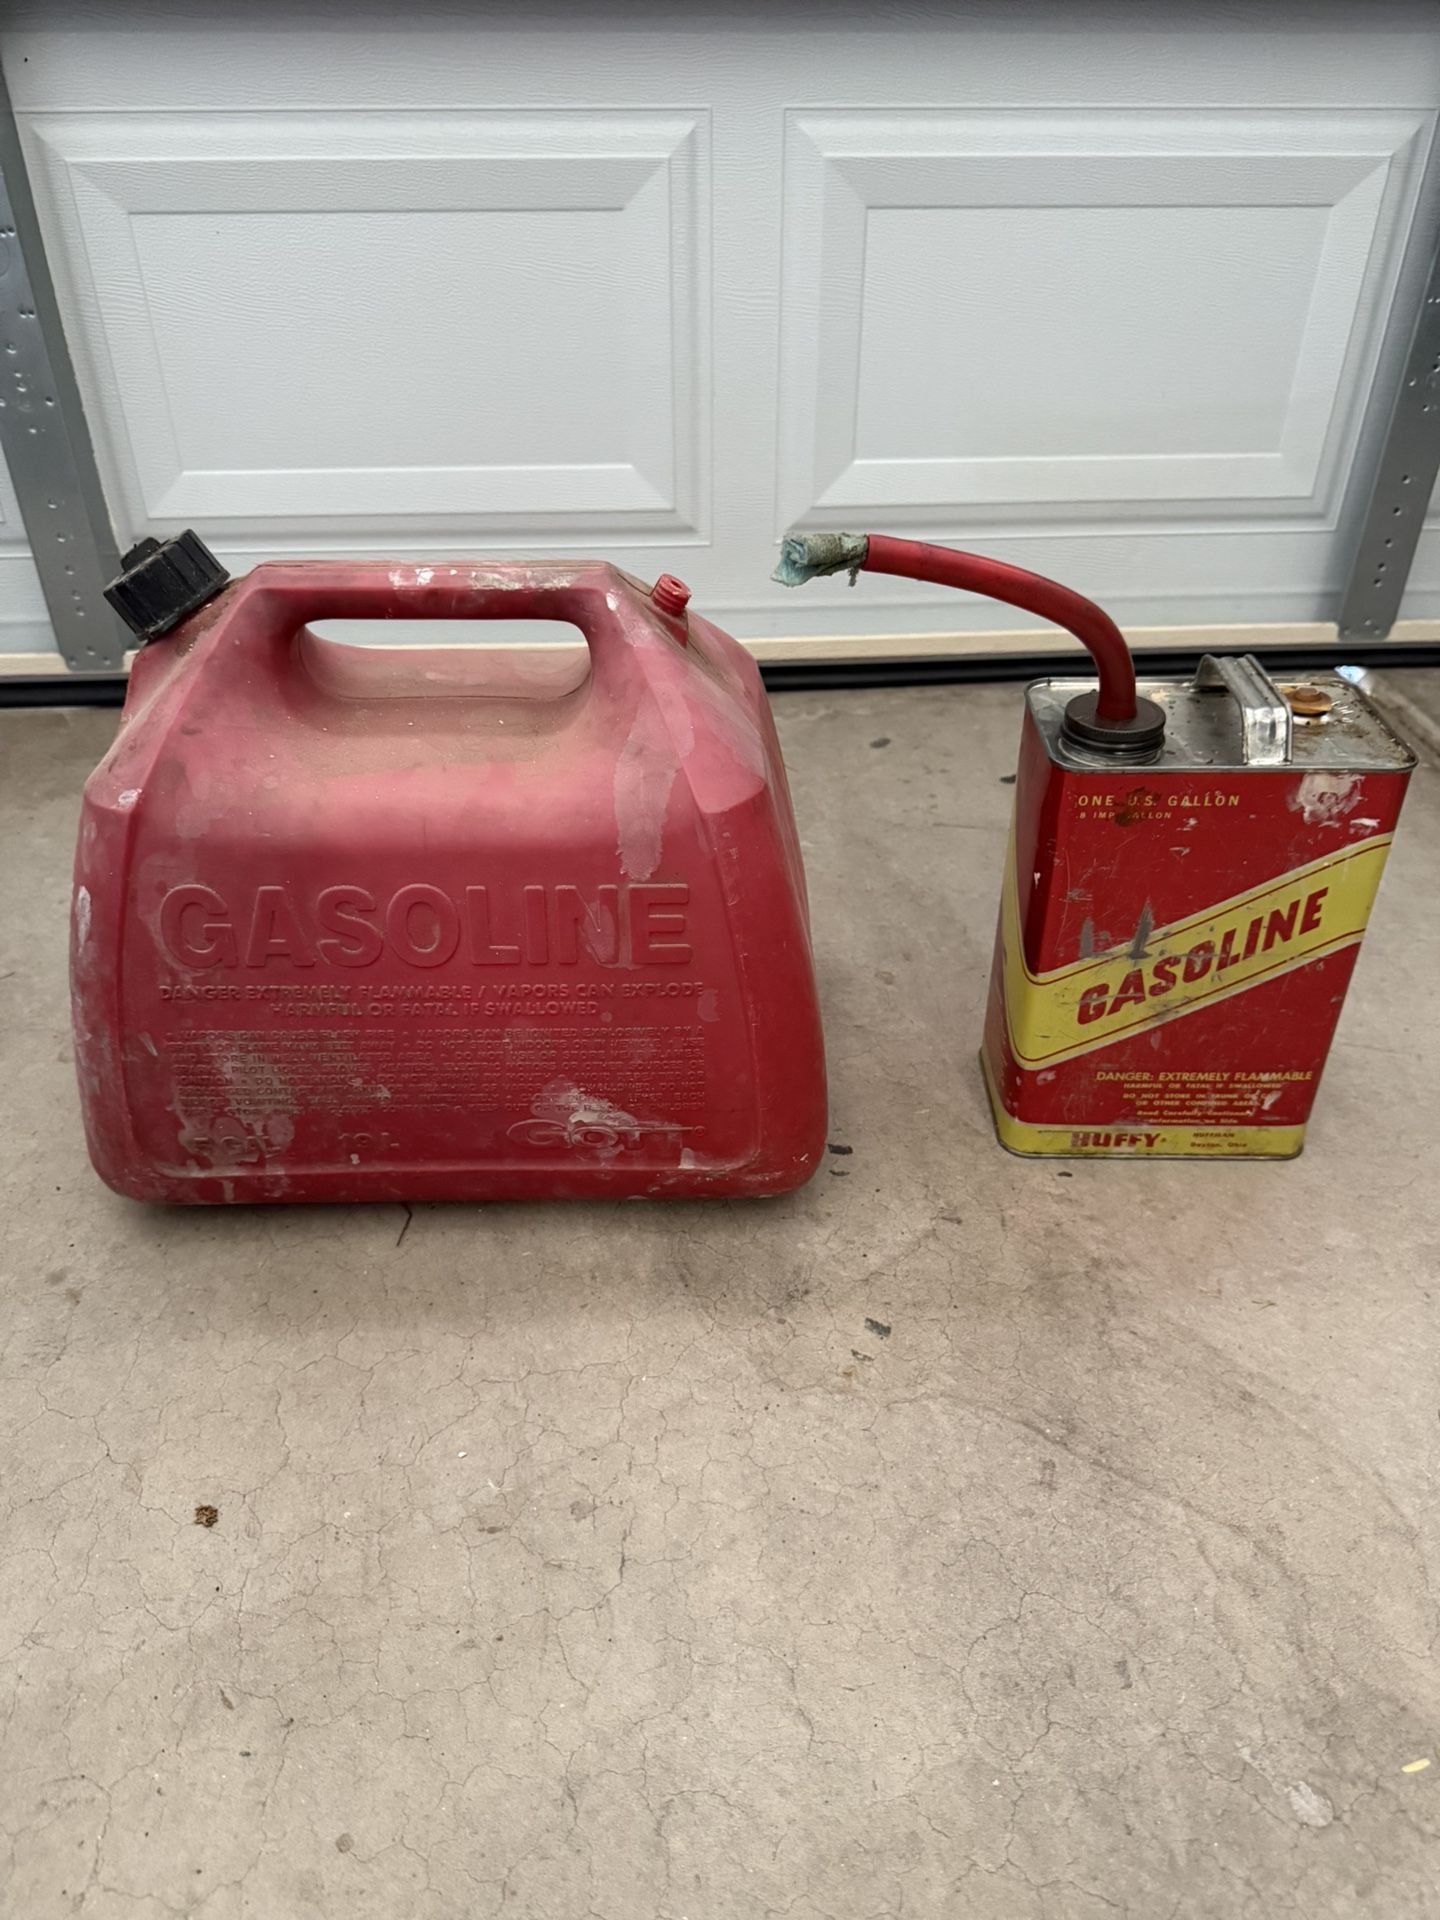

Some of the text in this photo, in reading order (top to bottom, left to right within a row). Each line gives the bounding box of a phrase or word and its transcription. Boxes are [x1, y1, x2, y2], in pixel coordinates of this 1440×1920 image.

[1078, 795, 1115, 806] ONE
[1167, 794, 1240, 806] GALLON
[160, 883, 693, 969] GASOLINE
[1077, 887, 1329, 1025] GASOLINE
[358, 983, 472, 999] FLAMMABLE
[493, 983, 569, 997] VAPORS
[576, 983, 614, 997] CAN
[622, 982, 704, 996] EXPLODE
[270, 1002, 600, 1017] HARMFUL OR FATAL IF SWALLOWED
[1096, 1071, 1313, 1081] DANGER: EXTREMELY FLAMMABLE
[1071, 1131, 1161, 1148] HUFFY
